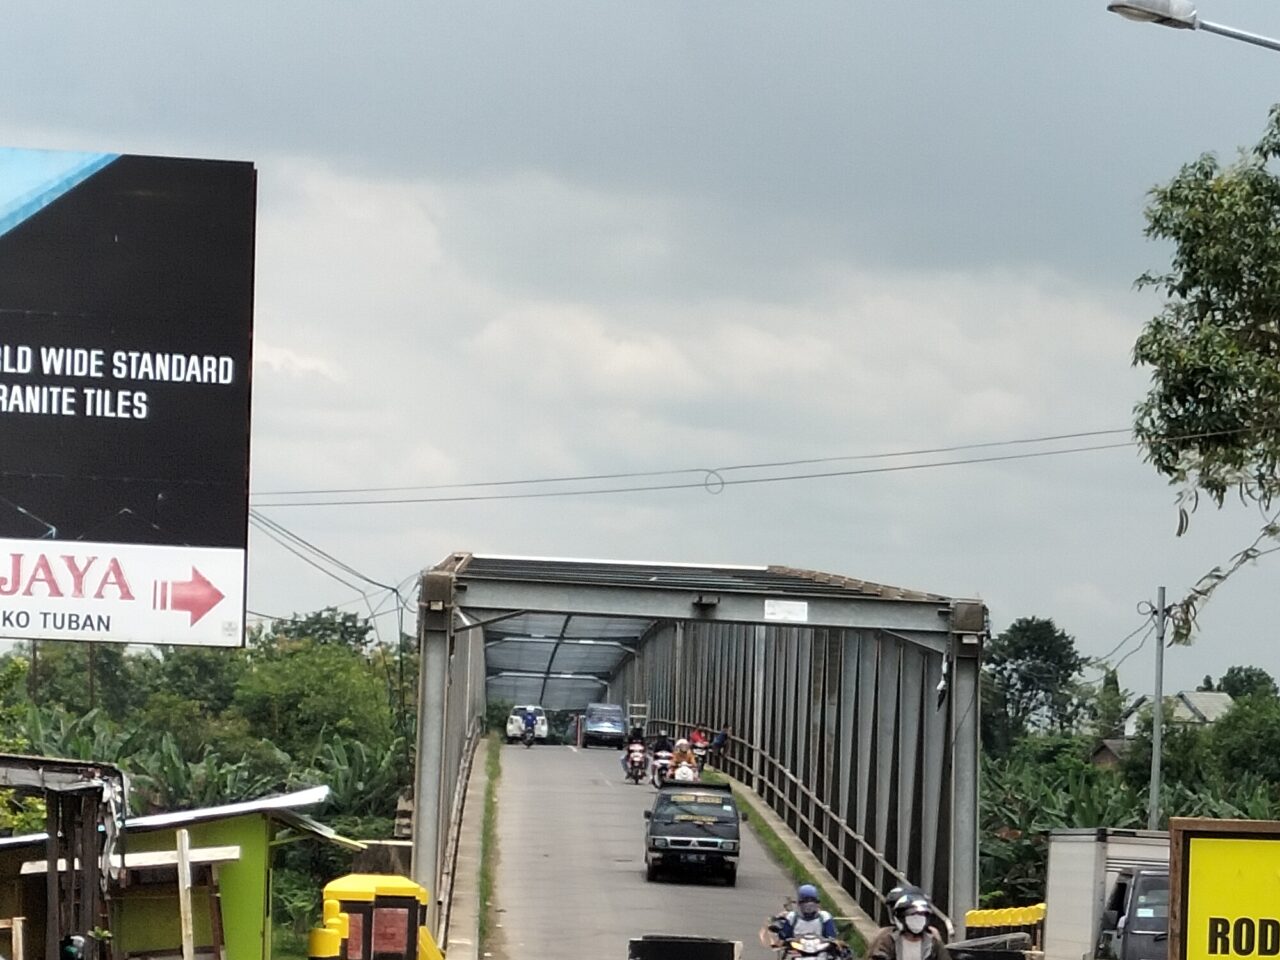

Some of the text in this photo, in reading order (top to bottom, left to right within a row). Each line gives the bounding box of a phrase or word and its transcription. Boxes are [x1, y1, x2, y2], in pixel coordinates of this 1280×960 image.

[0, 345, 234, 384] LD WIDE STANDARD
[84, 388, 147, 419] TILES
[0, 553, 135, 601] JAYA
[40, 612, 111, 632] TUBAN
